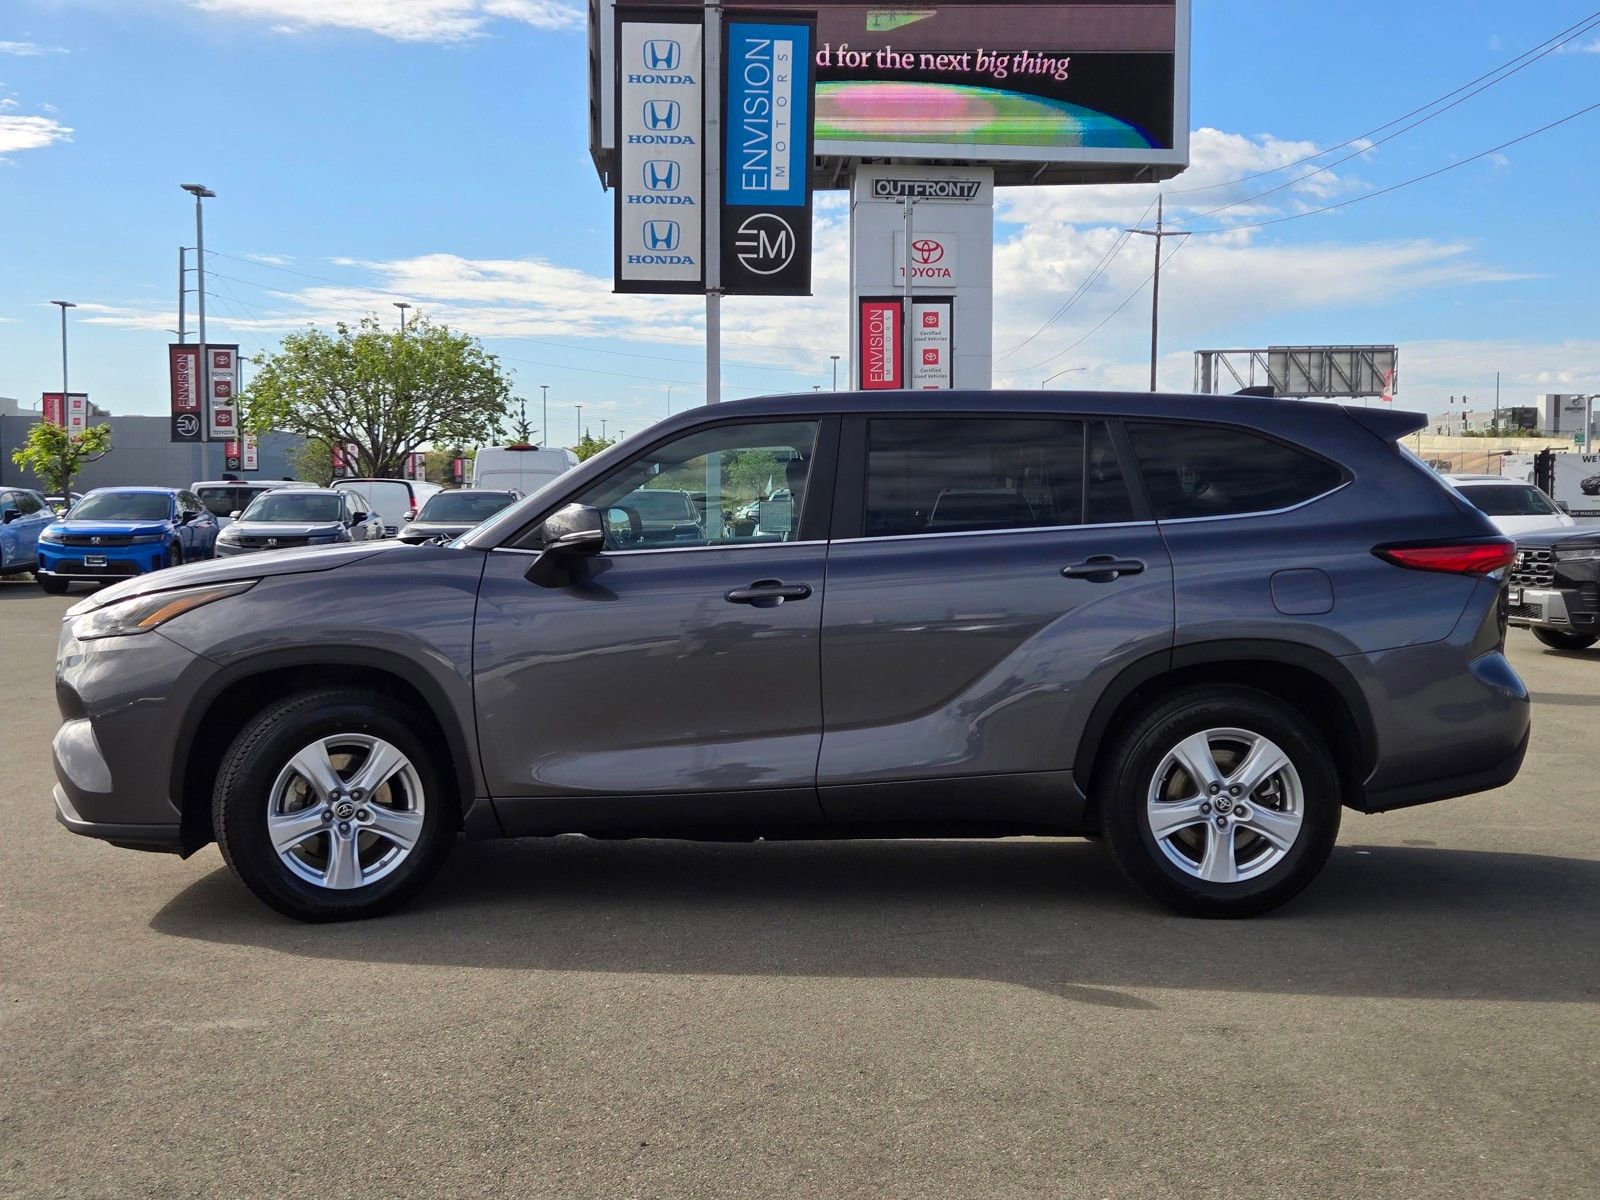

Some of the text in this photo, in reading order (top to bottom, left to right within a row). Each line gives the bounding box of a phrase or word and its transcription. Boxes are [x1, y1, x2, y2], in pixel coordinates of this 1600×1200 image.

[836, 43, 872, 68] for
[876, 45, 915, 69] the
[920, 52, 972, 71] next
[975, 48, 1010, 79] big
[1012, 49, 1071, 81] thing
[628, 74, 696, 85] HONDA
[742, 38, 771, 190] ENVISION
[775, 53, 788, 177] MOTORS
[627, 134, 696, 145] HONDA
[627, 194, 695, 205] HONDA
[627, 254, 695, 265] HONDA
[900, 267, 951, 278] TOYOTA
[870, 309, 883, 382] ENVISION
[176, 353, 189, 407] ENVISION
